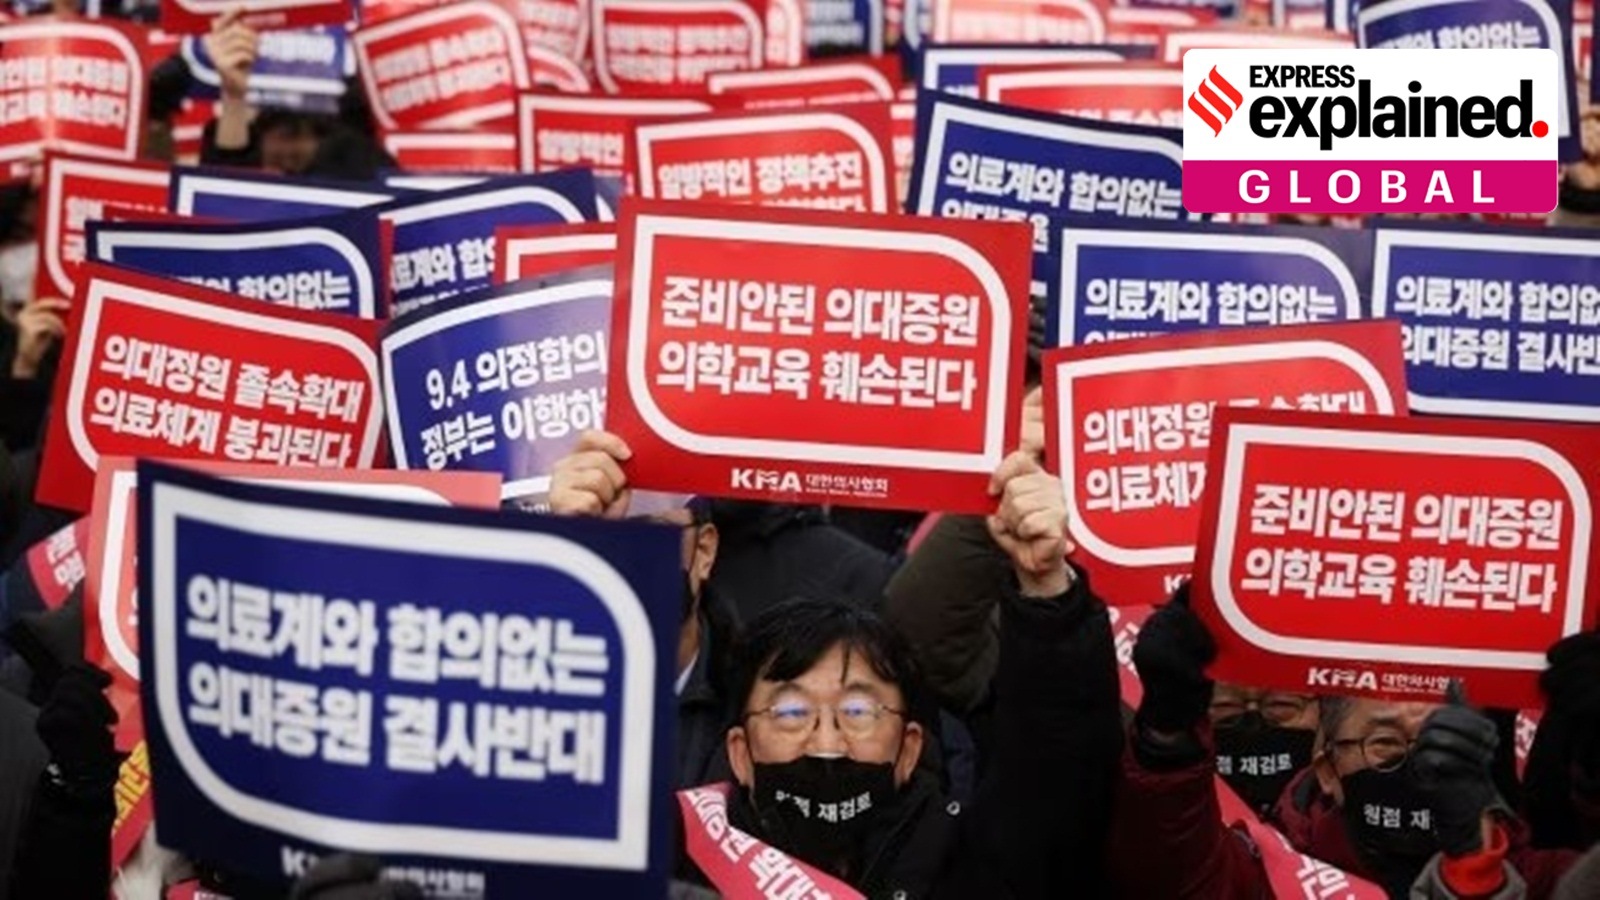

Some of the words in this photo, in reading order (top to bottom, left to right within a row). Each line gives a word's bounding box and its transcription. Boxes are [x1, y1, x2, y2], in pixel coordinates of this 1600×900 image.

[658, 159, 751, 200] 일방적인
[755, 151, 863, 194] 정책추진
[945, 152, 1064, 207] 의료계와
[1069, 172, 1184, 220] 합의없는
[391, 243, 456, 292] 료계와
[1394, 276, 1513, 322] 의료계와
[662, 276, 816, 336] 준비안된
[824, 288, 980, 347] 의대증원
[1084, 279, 1211, 323] 의료계와
[1217, 282, 1337, 325] 합의없는
[100, 335, 232, 400] 의대정원
[234, 361, 365, 423] 졸속확대
[425, 360, 472, 411] 9.4
[656, 341, 811, 400] 의학교육
[819, 350, 978, 411] 훼손된다
[90, 388, 221, 454] 의료체계
[224, 416, 352, 468] 붕괴된다
[420, 412, 496, 472] 정부는
[501, 387, 608, 441] 이행하
[1083, 401, 1218, 455] 의대정원
[1250, 484, 1405, 542] 준비안된
[1411, 494, 1563, 550] 의대증원
[1241, 548, 1397, 604] 의학교육
[1404, 556, 1557, 613] 훼손된다
[187, 574, 378, 677] 의료계와
[387, 603, 609, 697] 합의없는
[188, 661, 372, 767] 의대증원
[383, 694, 607, 784] 결사반대
